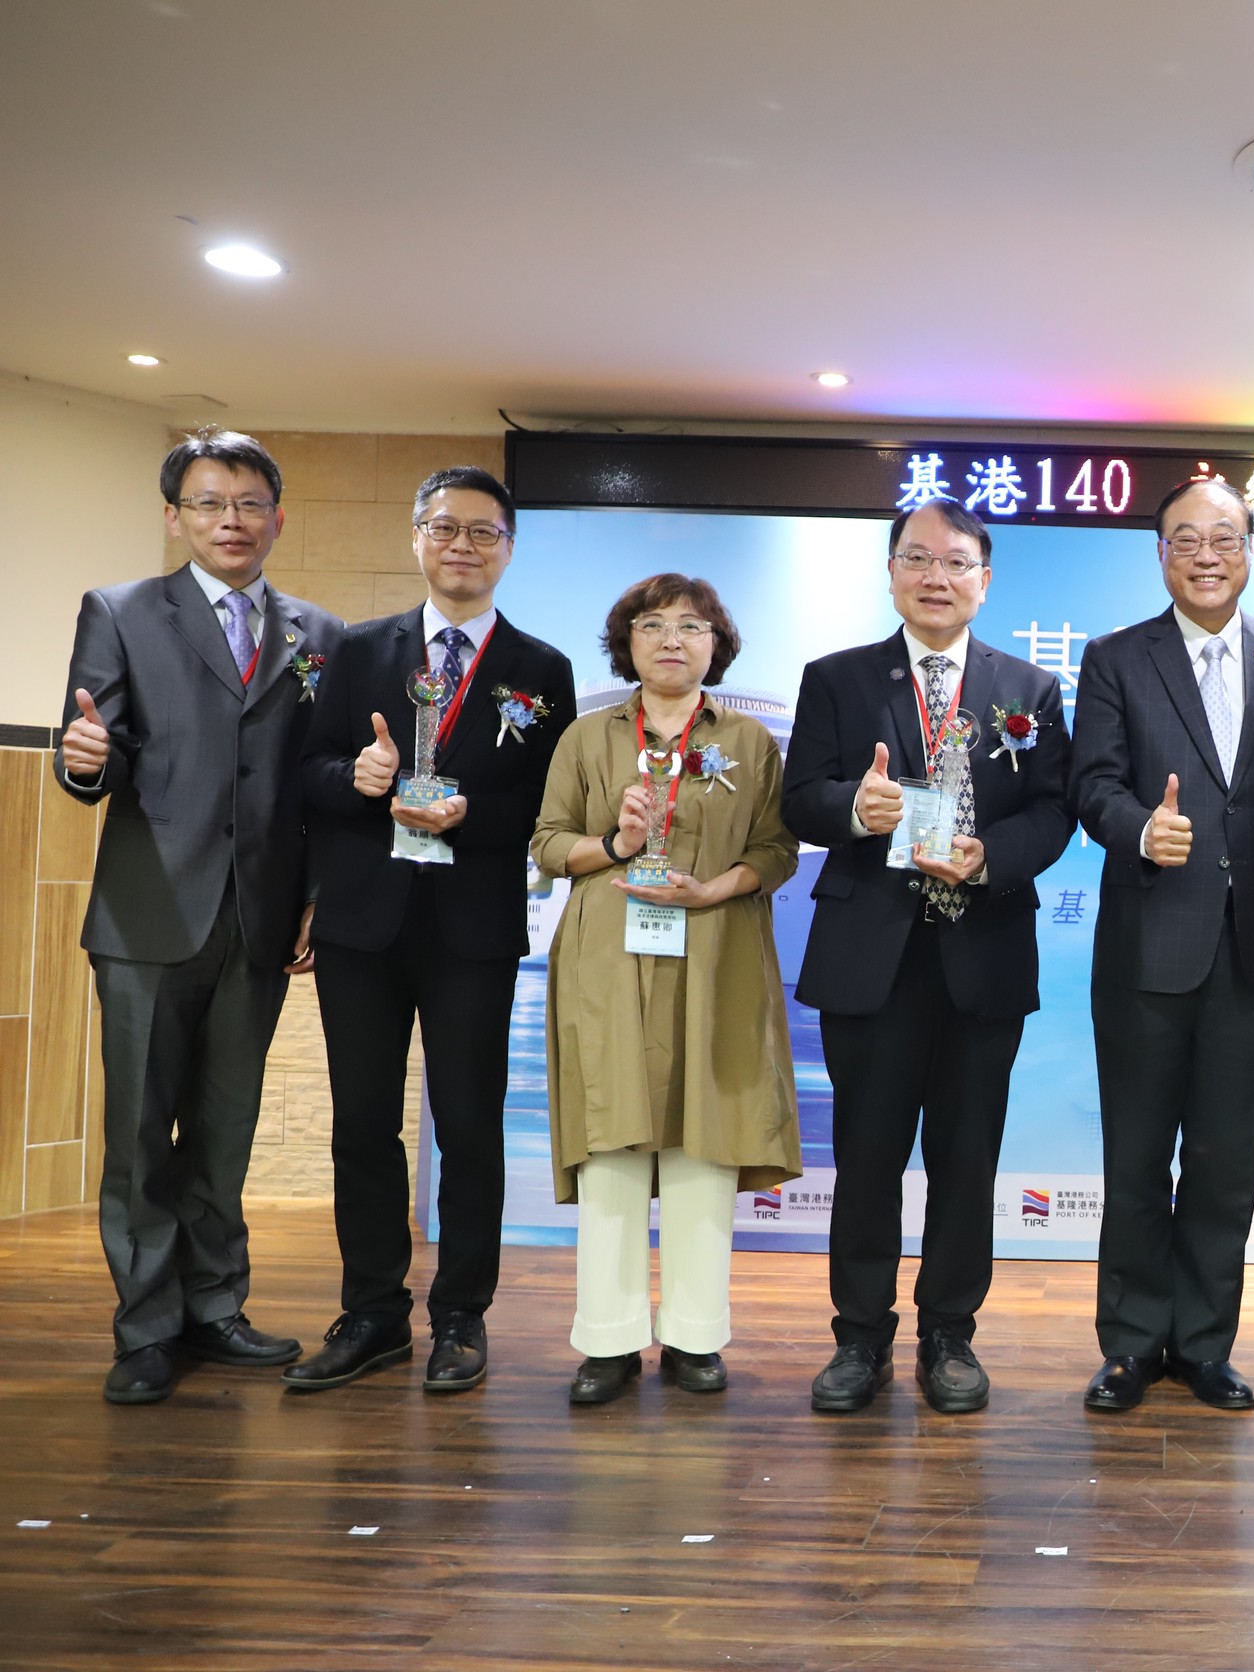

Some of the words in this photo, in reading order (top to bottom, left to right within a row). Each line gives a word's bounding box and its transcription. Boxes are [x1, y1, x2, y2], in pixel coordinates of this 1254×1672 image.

[896, 453, 1131, 516] 基港140
[1012, 621, 1087, 705] 基
[1052, 890, 1087, 924] 基
[789, 1192, 833, 1203] 臺灣港務
[1057, 1191, 1099, 1199] 臺灣港務公司
[754, 1211, 780, 1219] TIPC
[1022, 1218, 1049, 1227] TIPC
